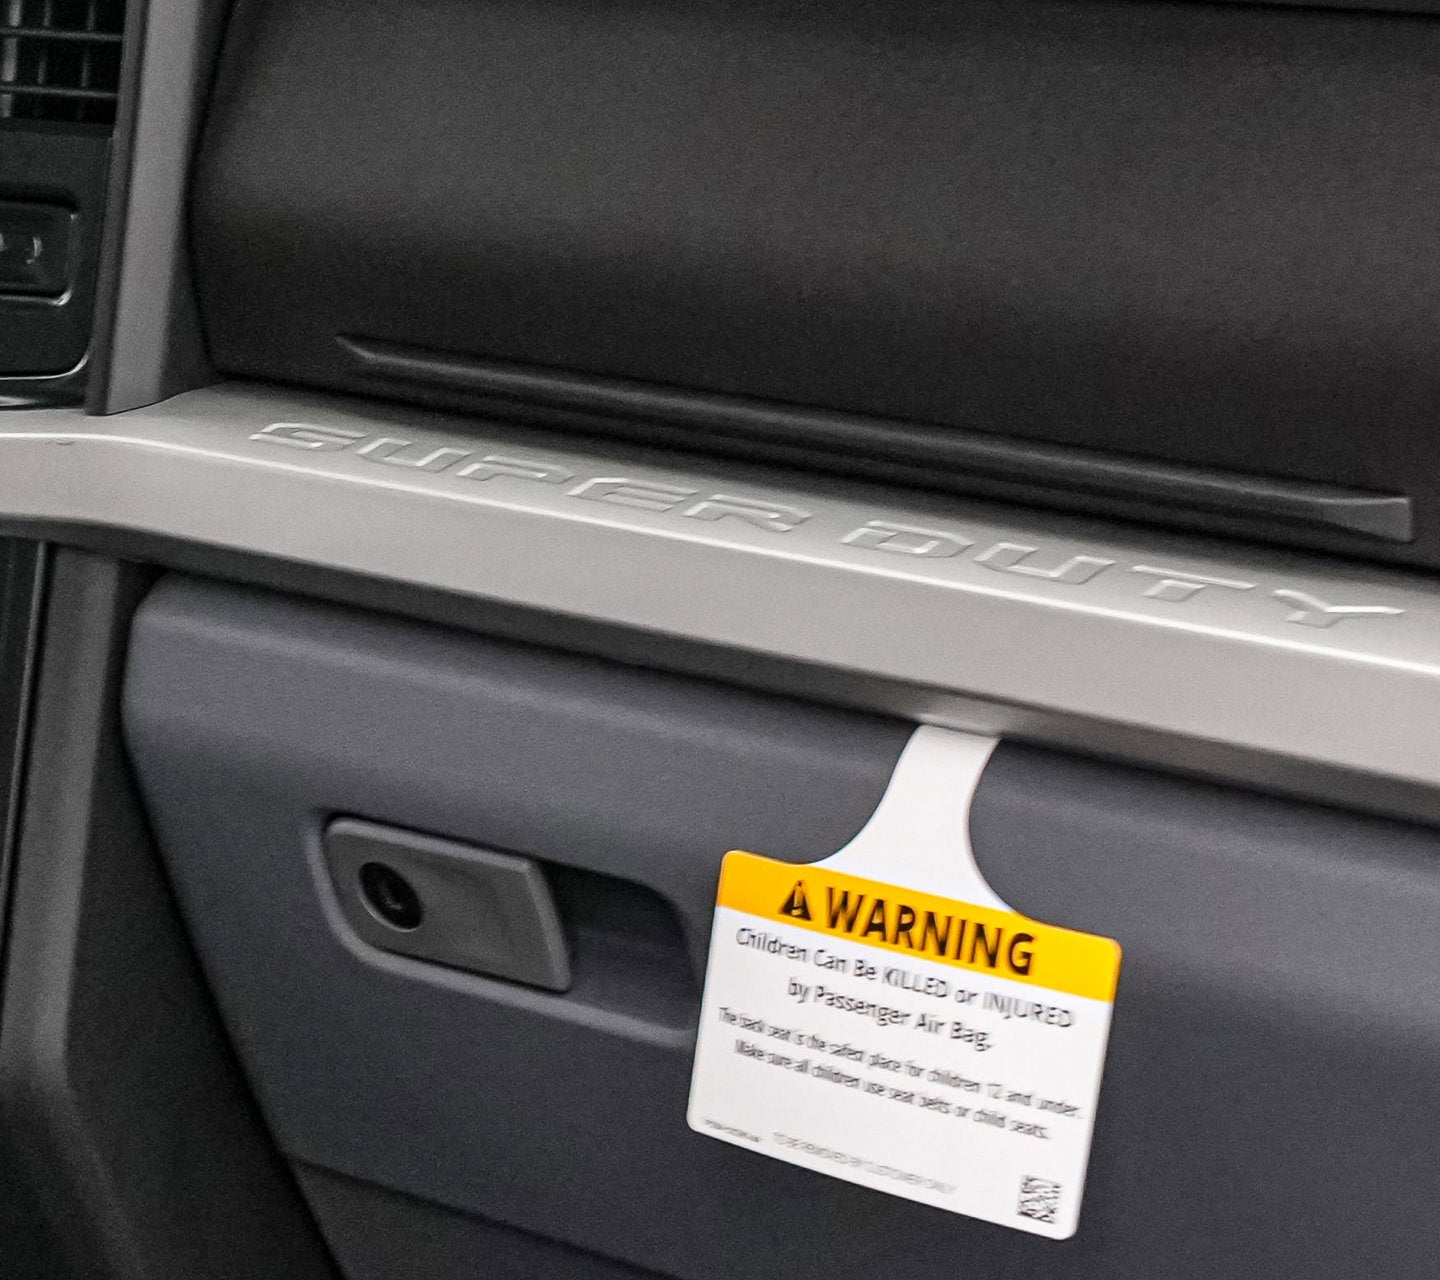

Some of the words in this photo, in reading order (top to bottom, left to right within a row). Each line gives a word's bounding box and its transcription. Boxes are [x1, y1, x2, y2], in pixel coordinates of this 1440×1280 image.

[248, 422, 813, 533] SUPER
[841, 520, 1407, 629] DUTY
[825, 886, 1036, 976] WARNING
[719, 1006, 737, 1026] The
[736, 927, 808, 962] Children
[814, 949, 847, 973] Can
[854, 958, 878, 980] Be
[882, 966, 948, 998] KILLED
[955, 989, 978, 1004] or
[982, 991, 1075, 1028] INJURED
[788, 976, 809, 1004] by
[814, 984, 911, 1026] Passenger
[914, 1012, 945, 1034] Air
